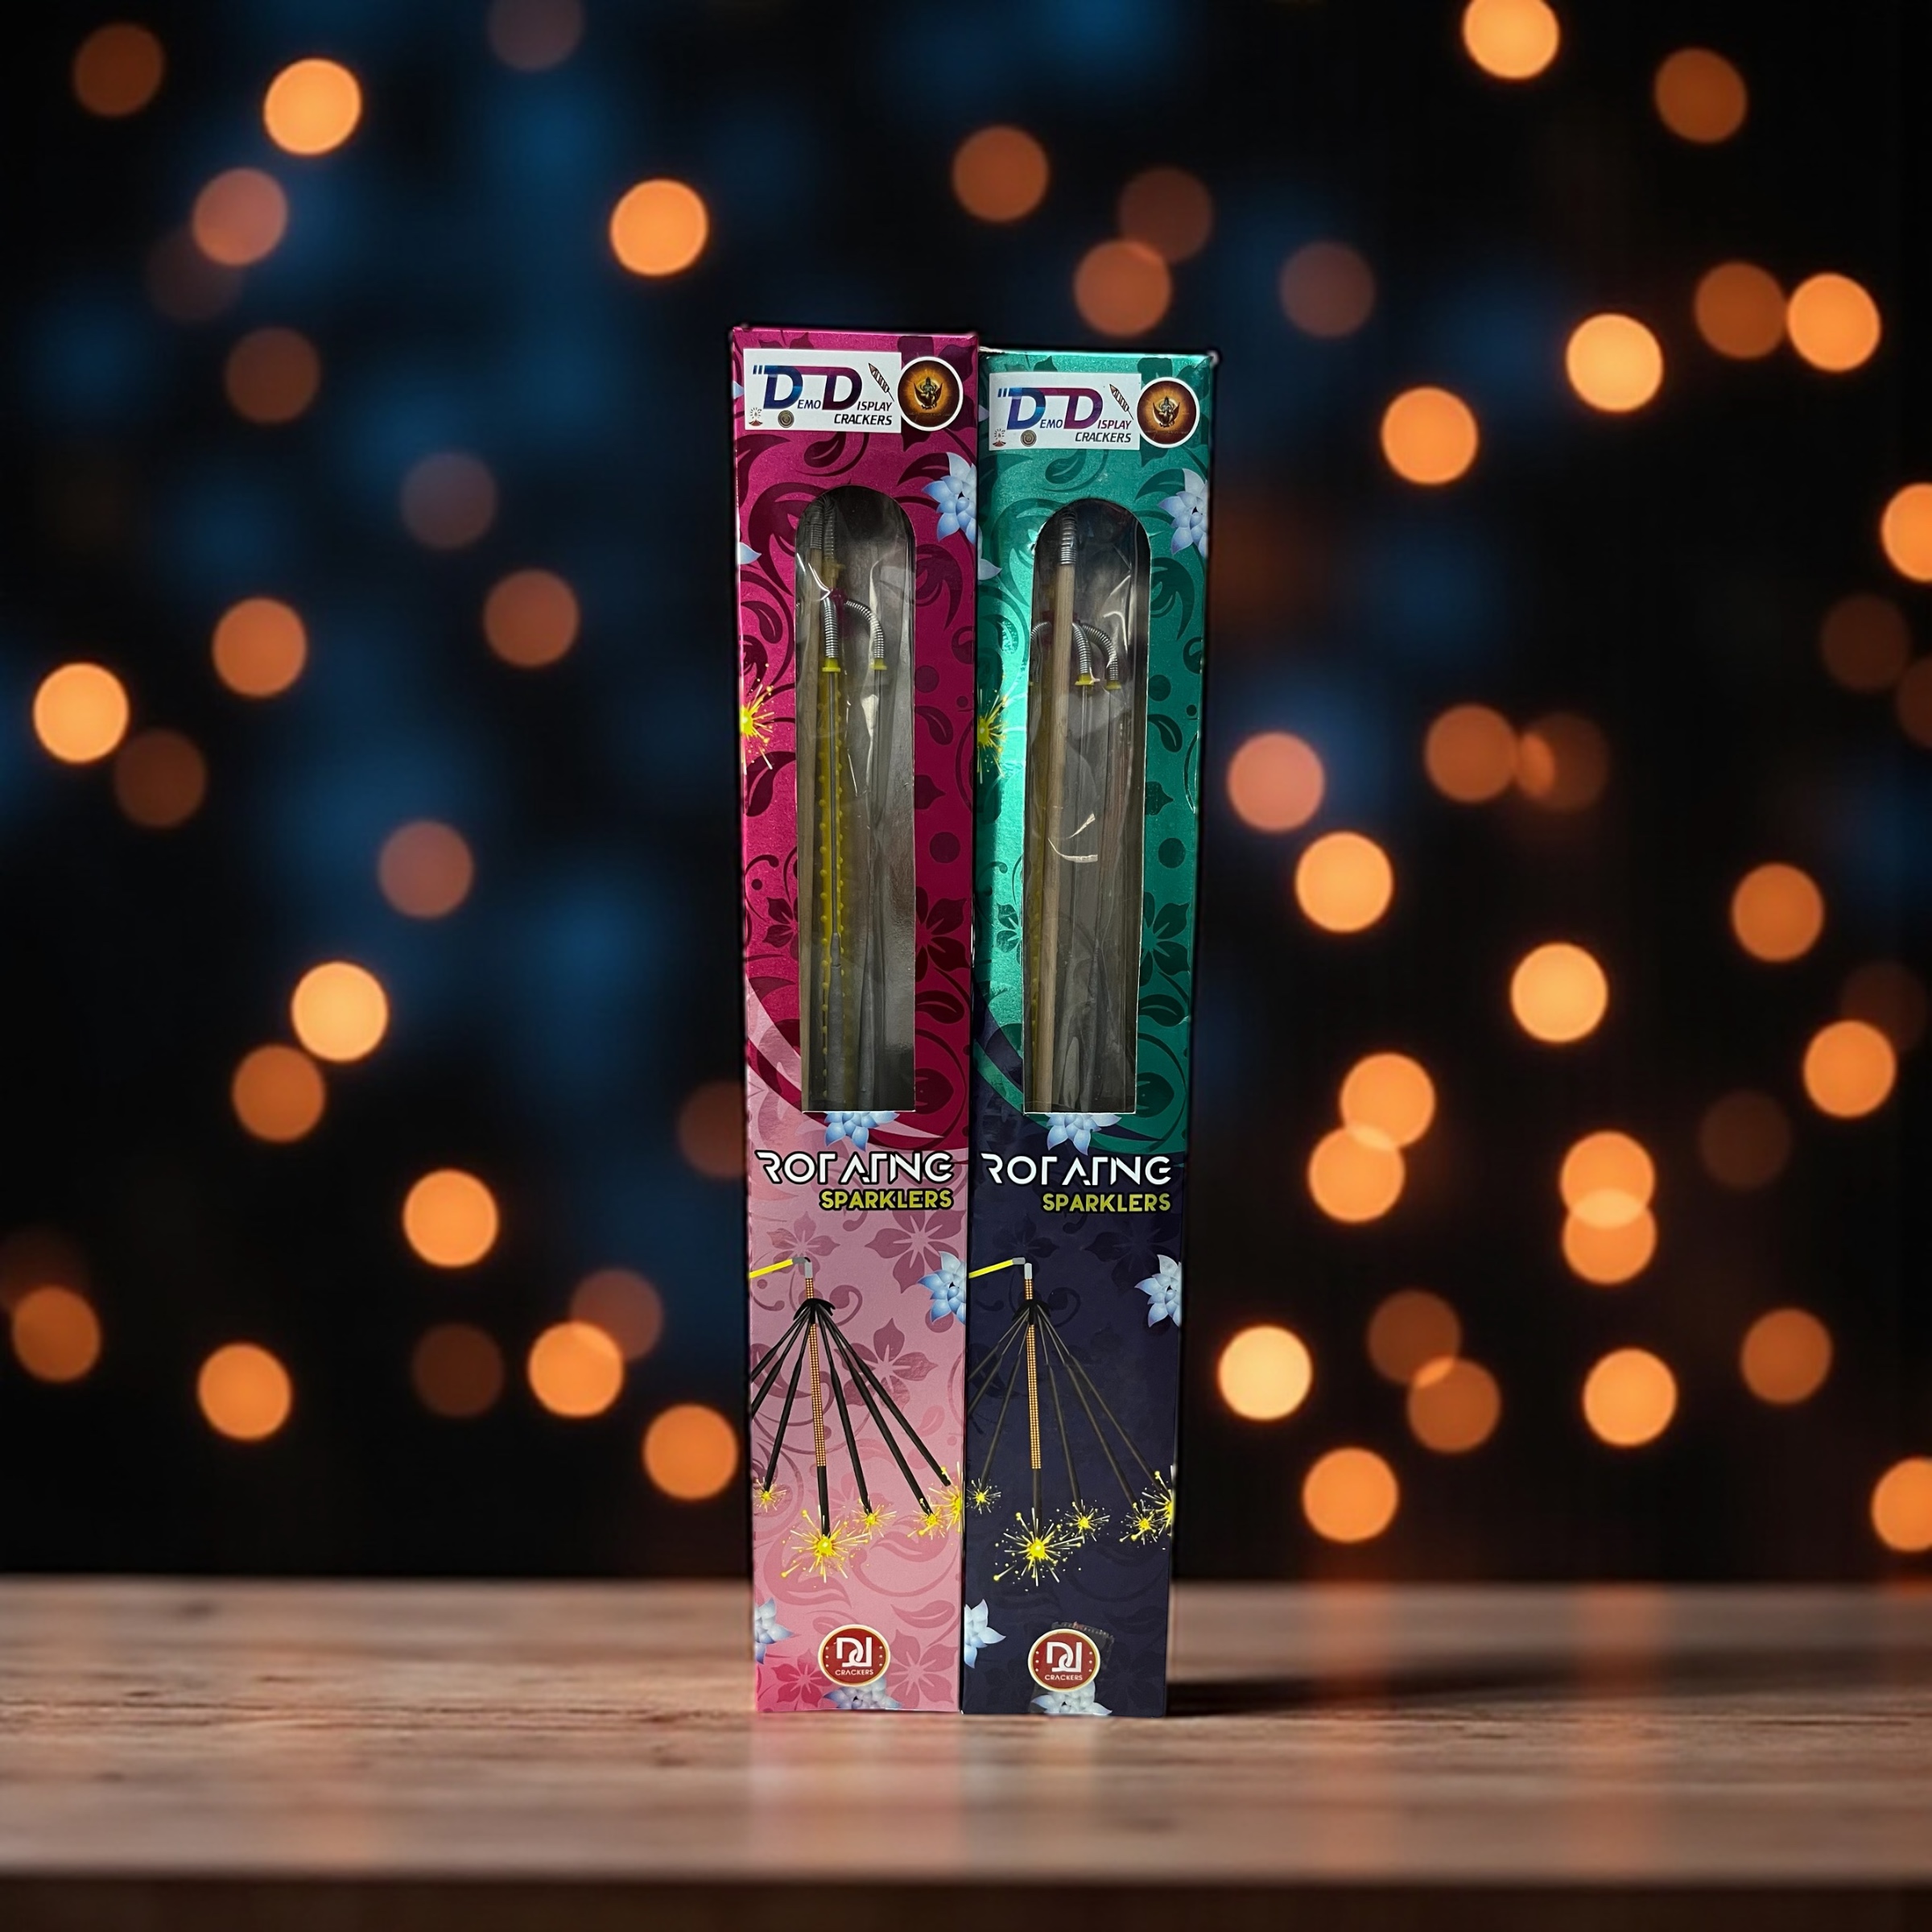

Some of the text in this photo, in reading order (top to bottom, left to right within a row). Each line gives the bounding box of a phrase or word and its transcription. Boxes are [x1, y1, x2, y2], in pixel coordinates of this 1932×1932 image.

[833, 413, 893, 426] CRACKERS
[1075, 431, 1132, 443] CRACKERS
[820, 1189, 953, 1209] SPARKLERS
[1042, 1192, 1171, 1212] SPARKLERS
